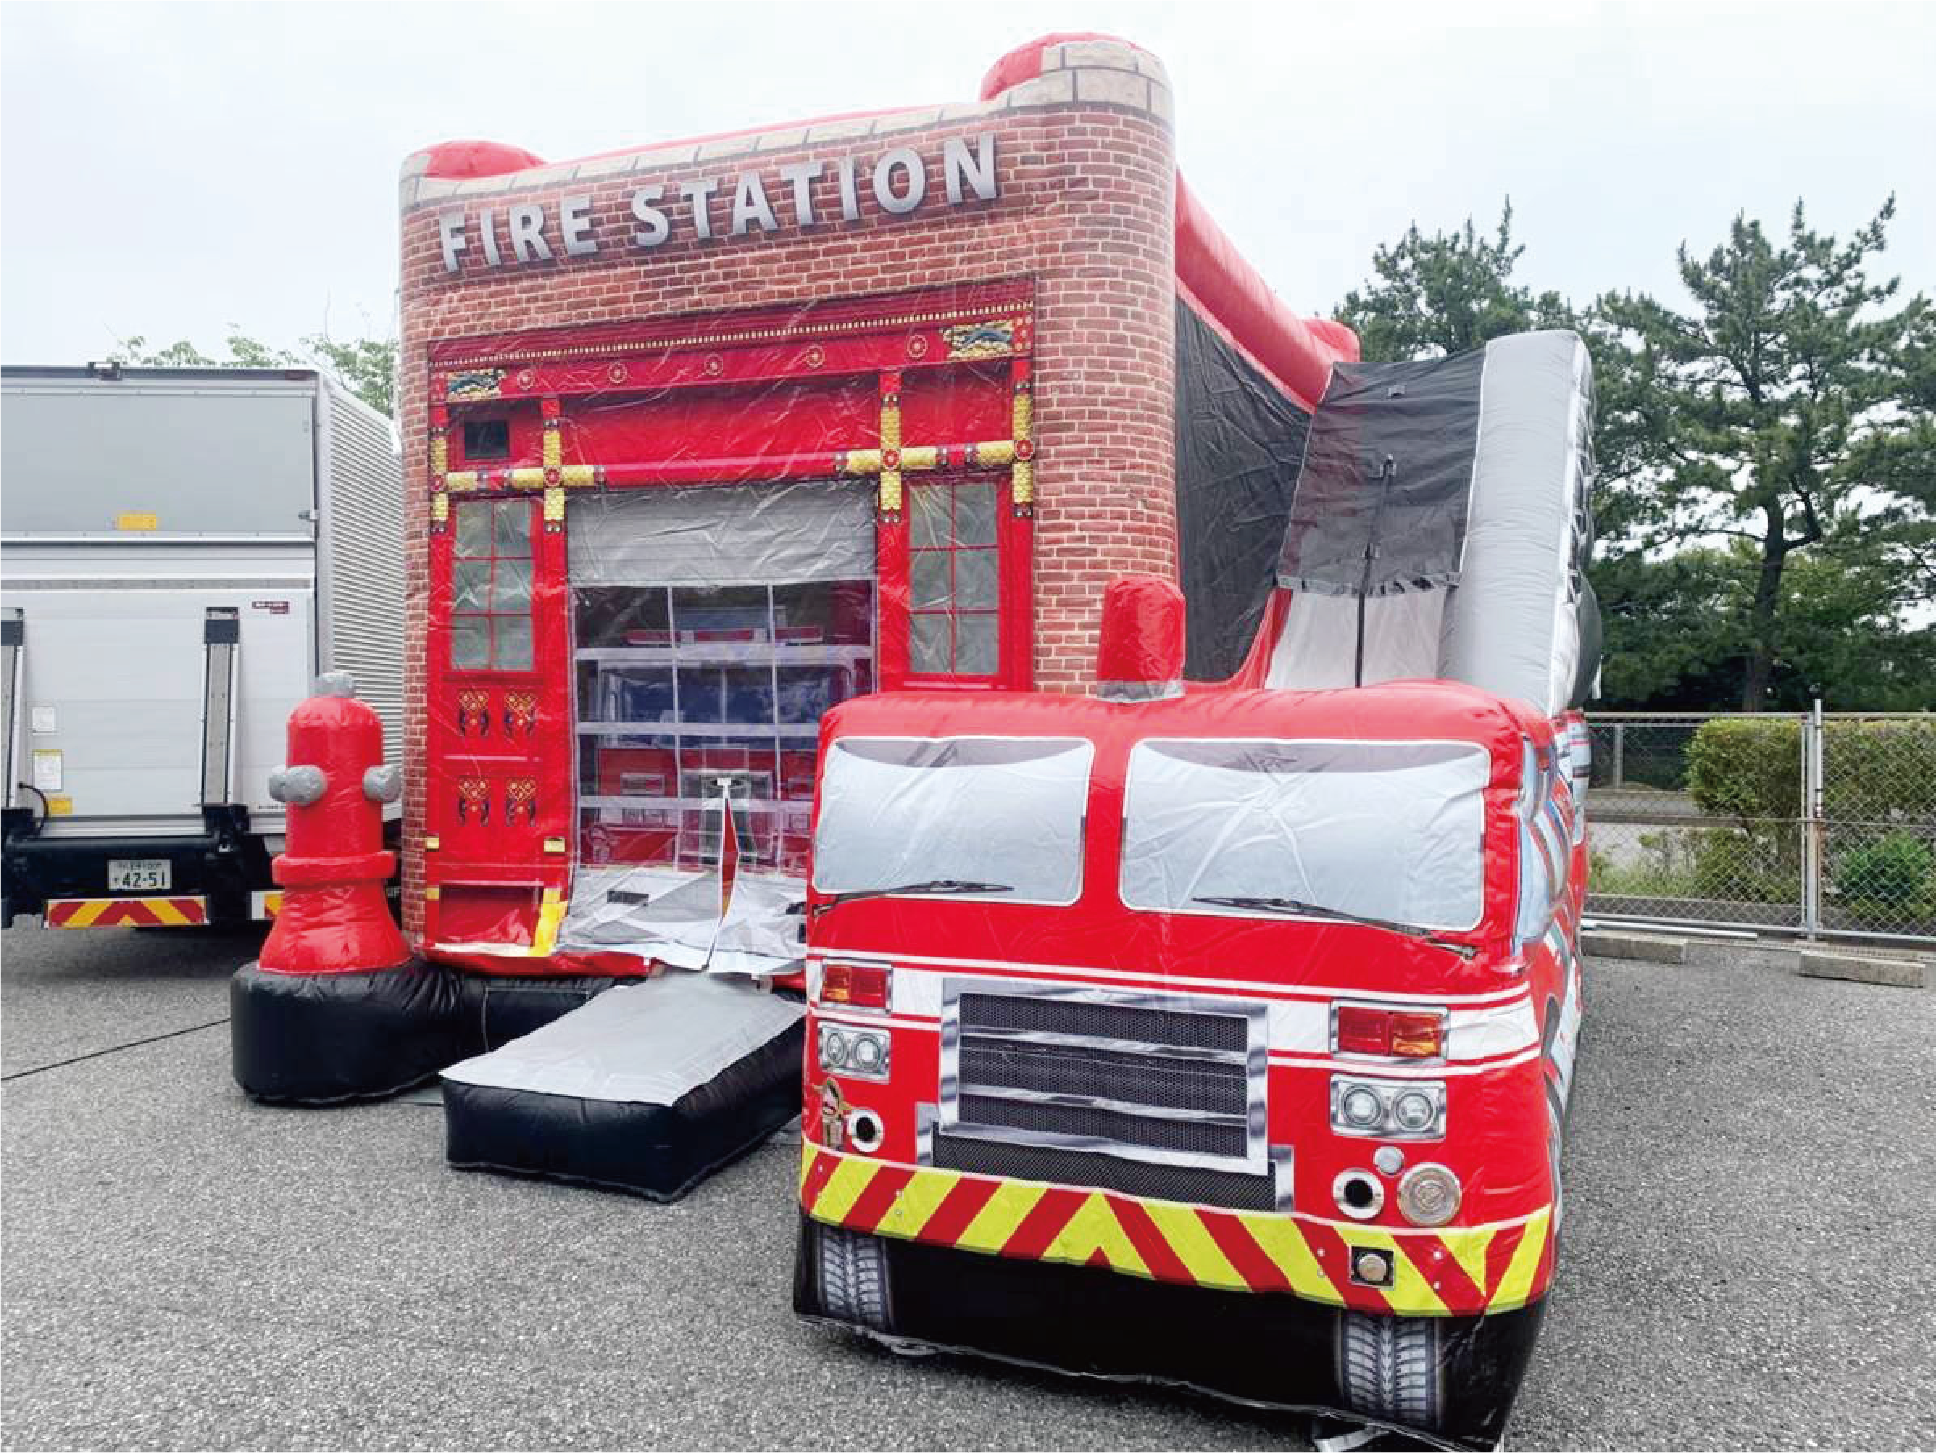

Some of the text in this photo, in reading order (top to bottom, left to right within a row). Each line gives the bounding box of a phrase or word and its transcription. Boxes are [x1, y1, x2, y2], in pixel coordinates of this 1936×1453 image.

[439, 133, 998, 273] FIRE STATION
[122, 871, 165, 888] 42-51
